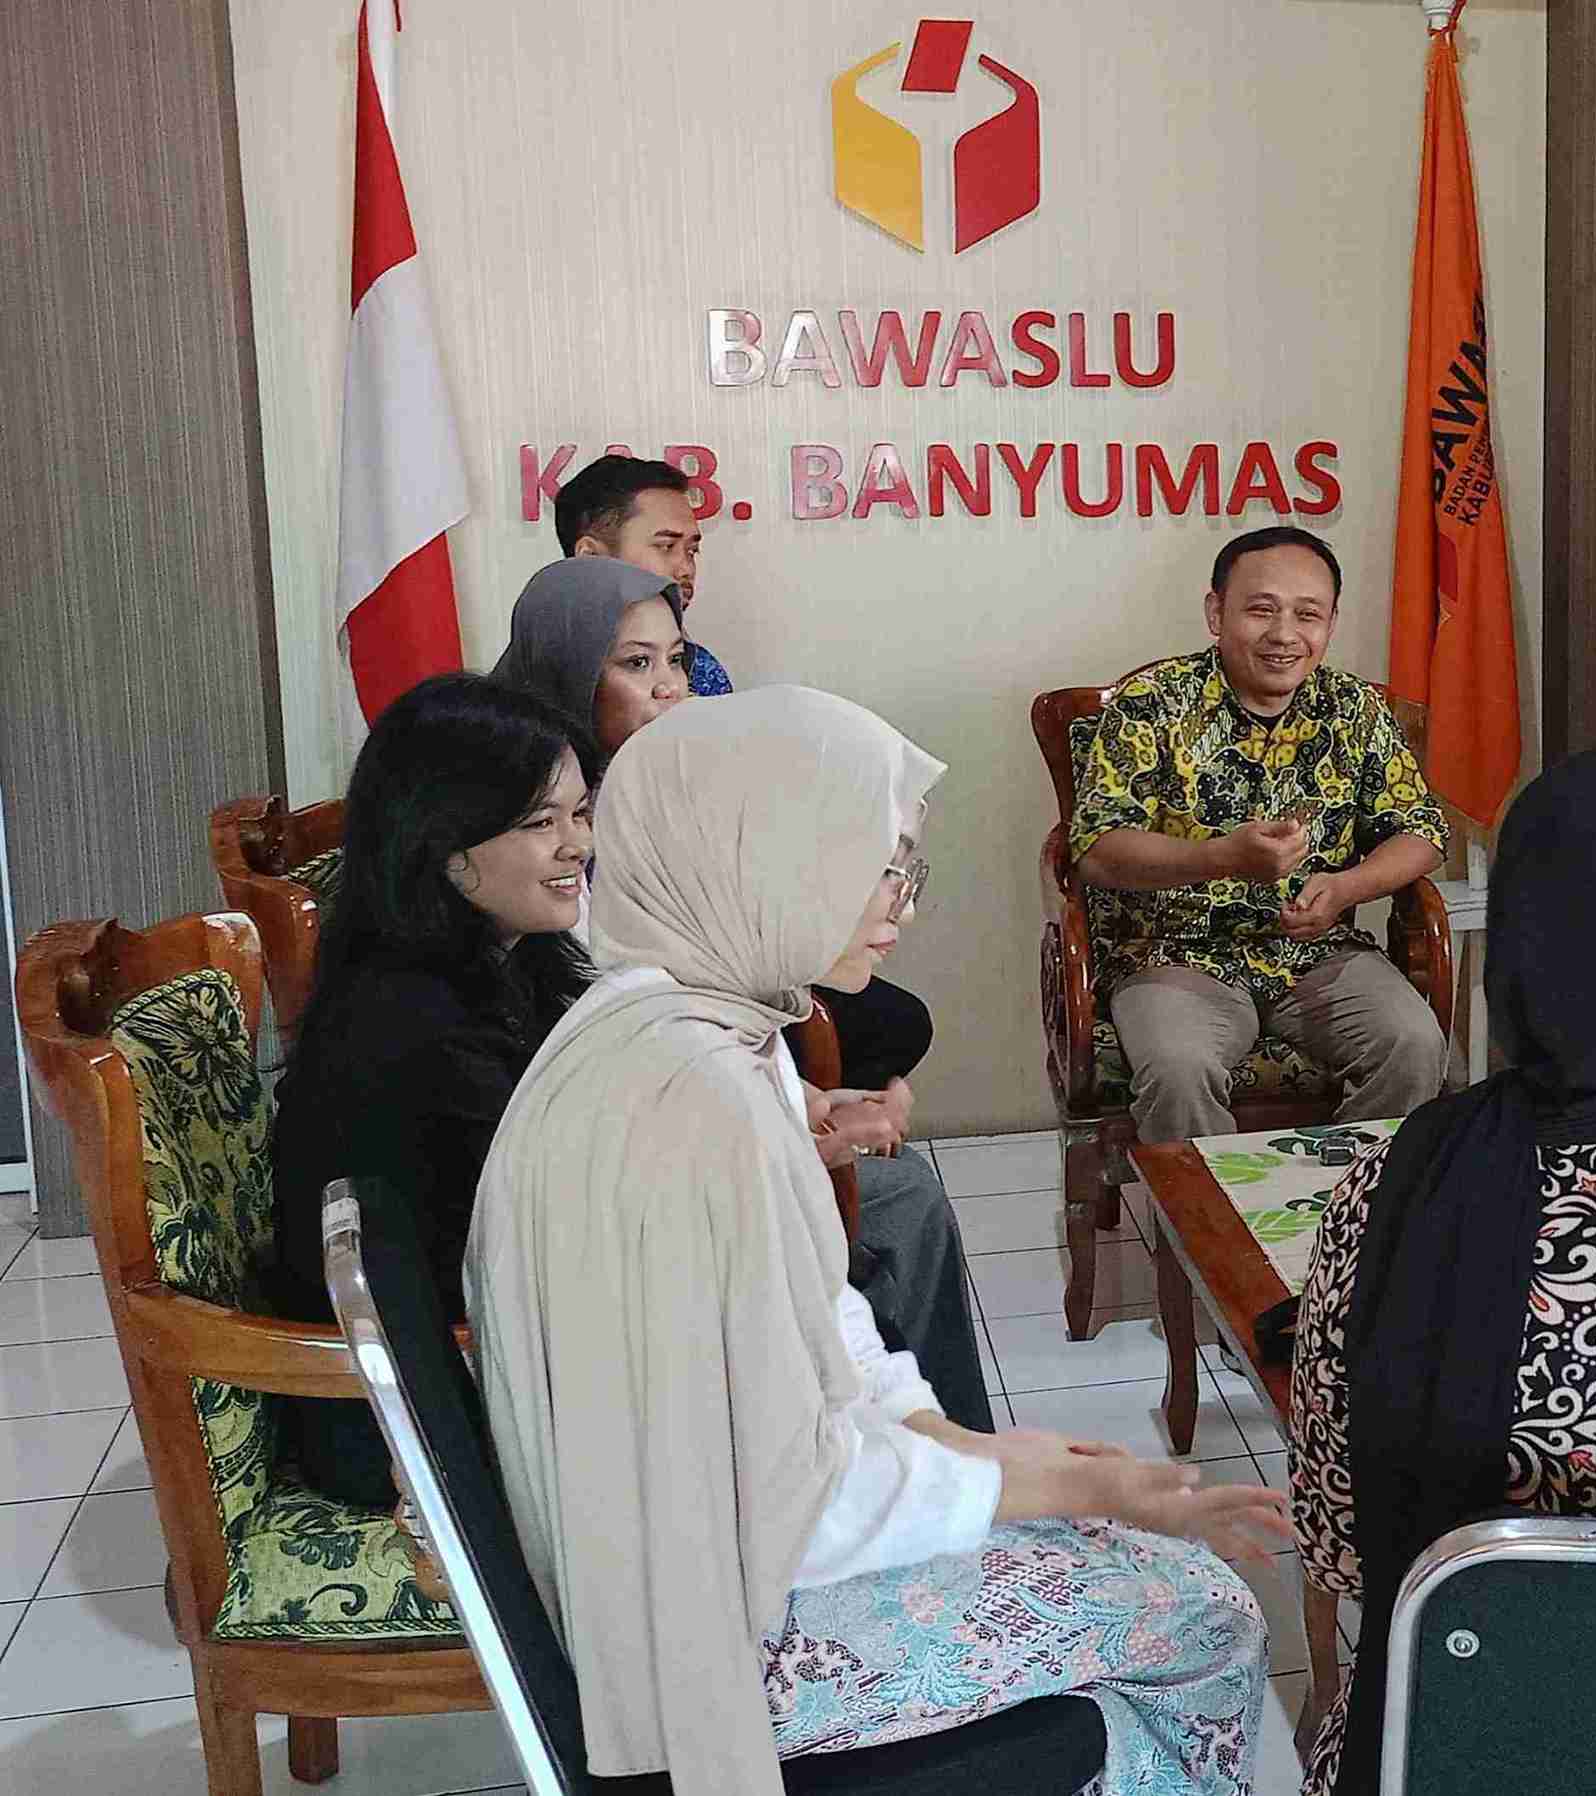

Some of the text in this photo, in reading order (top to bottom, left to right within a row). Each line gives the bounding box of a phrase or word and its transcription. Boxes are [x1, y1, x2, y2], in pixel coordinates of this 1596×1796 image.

[706, 308, 1176, 389] BAWASLU
[519, 440, 1344, 522] KB. BANYUMAS
[1443, 459, 1476, 516] BADAN
